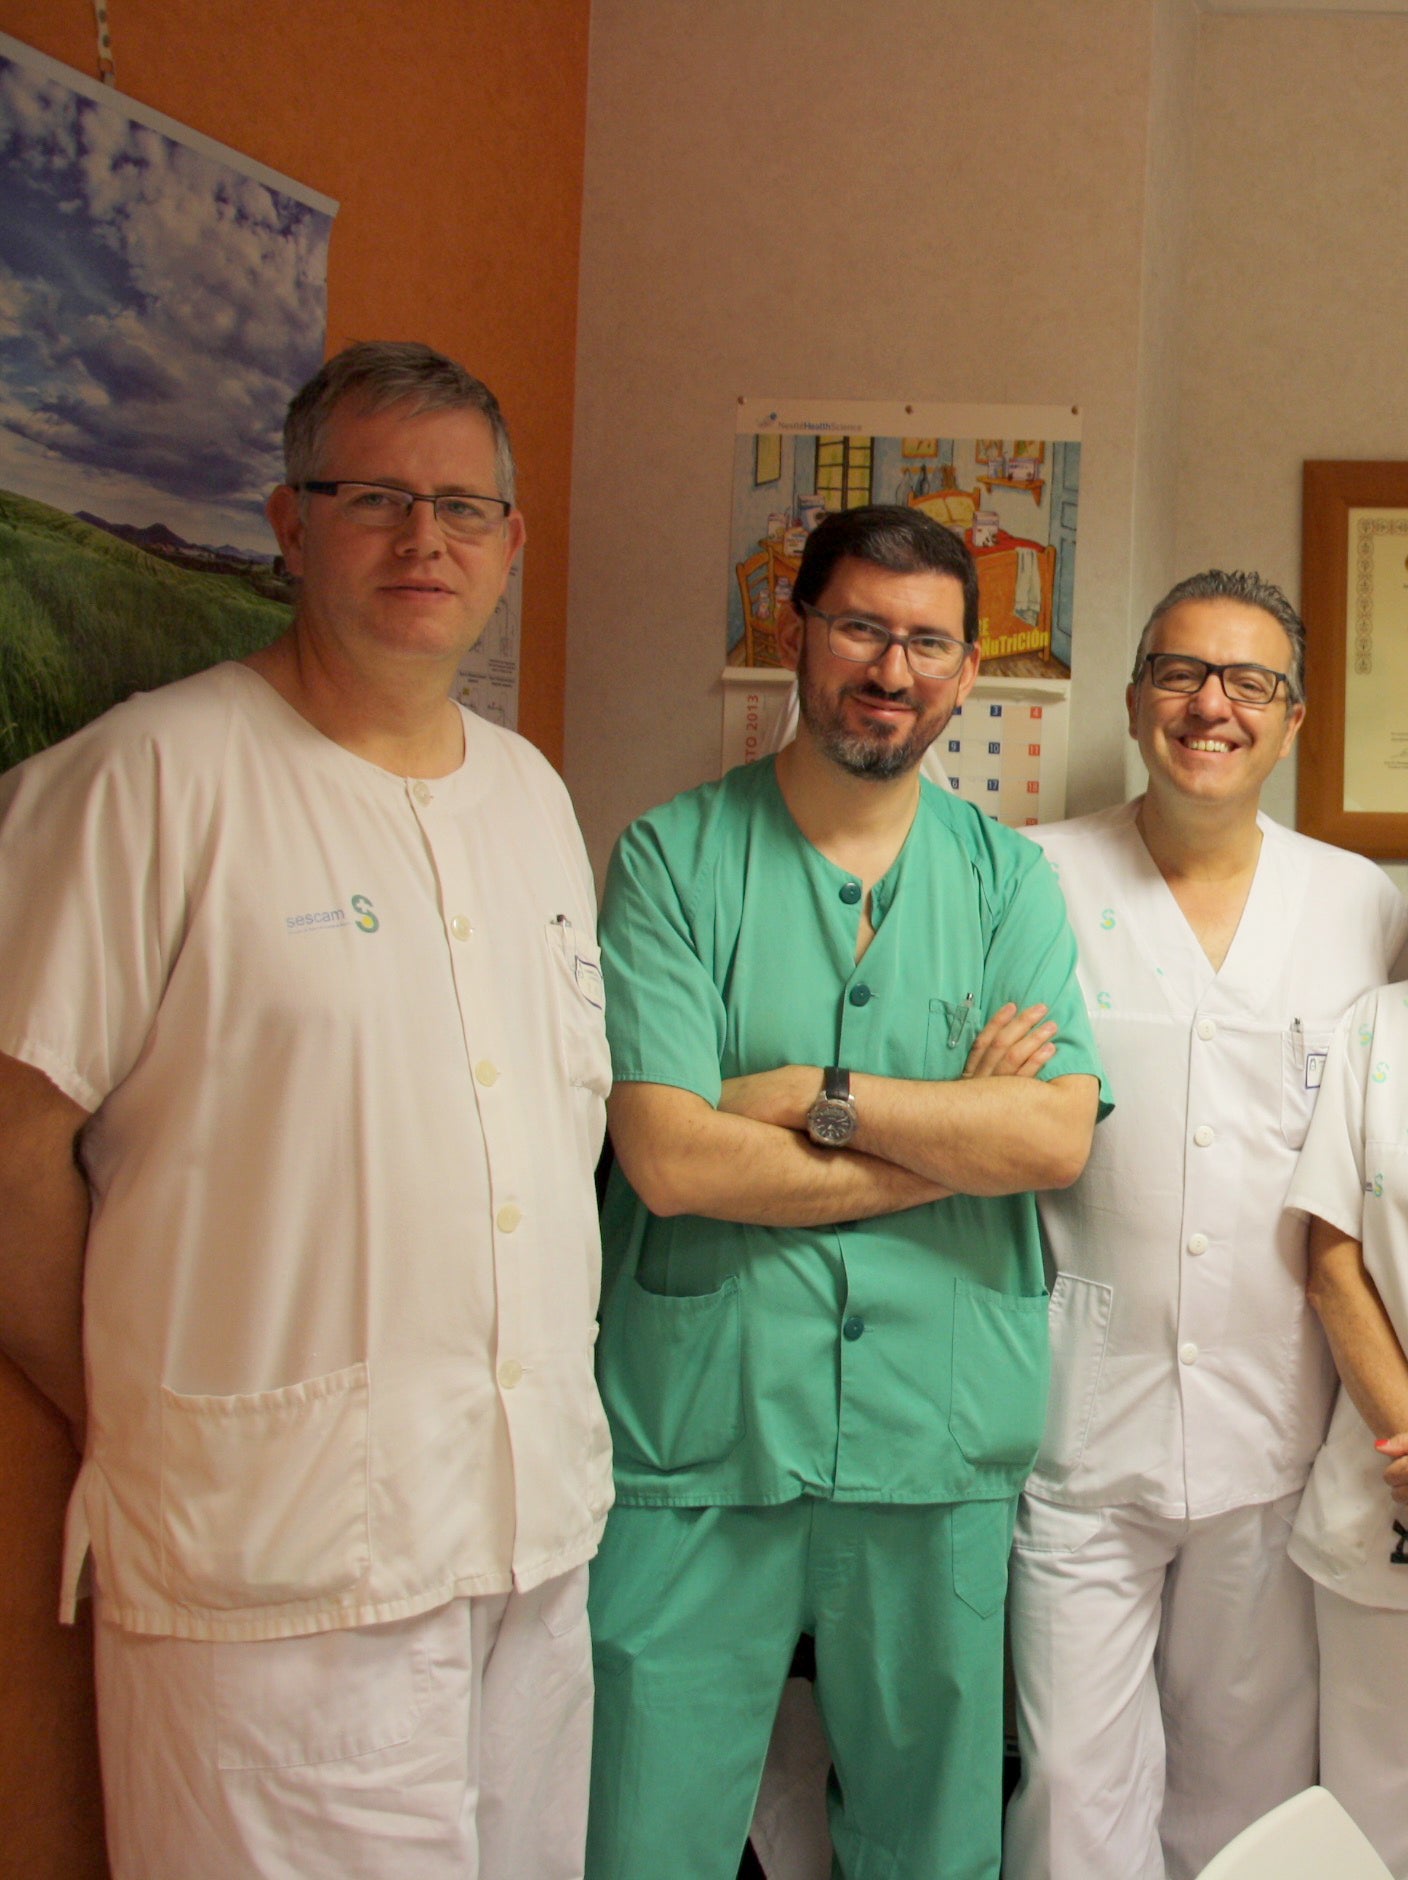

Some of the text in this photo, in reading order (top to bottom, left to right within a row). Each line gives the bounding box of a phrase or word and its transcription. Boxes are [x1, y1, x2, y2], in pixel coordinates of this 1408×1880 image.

[746, 694, 759, 731] 2013
[989, 743, 1000, 754] 10
[988, 780, 999, 791] 17
[286, 908, 346, 929] sescam
